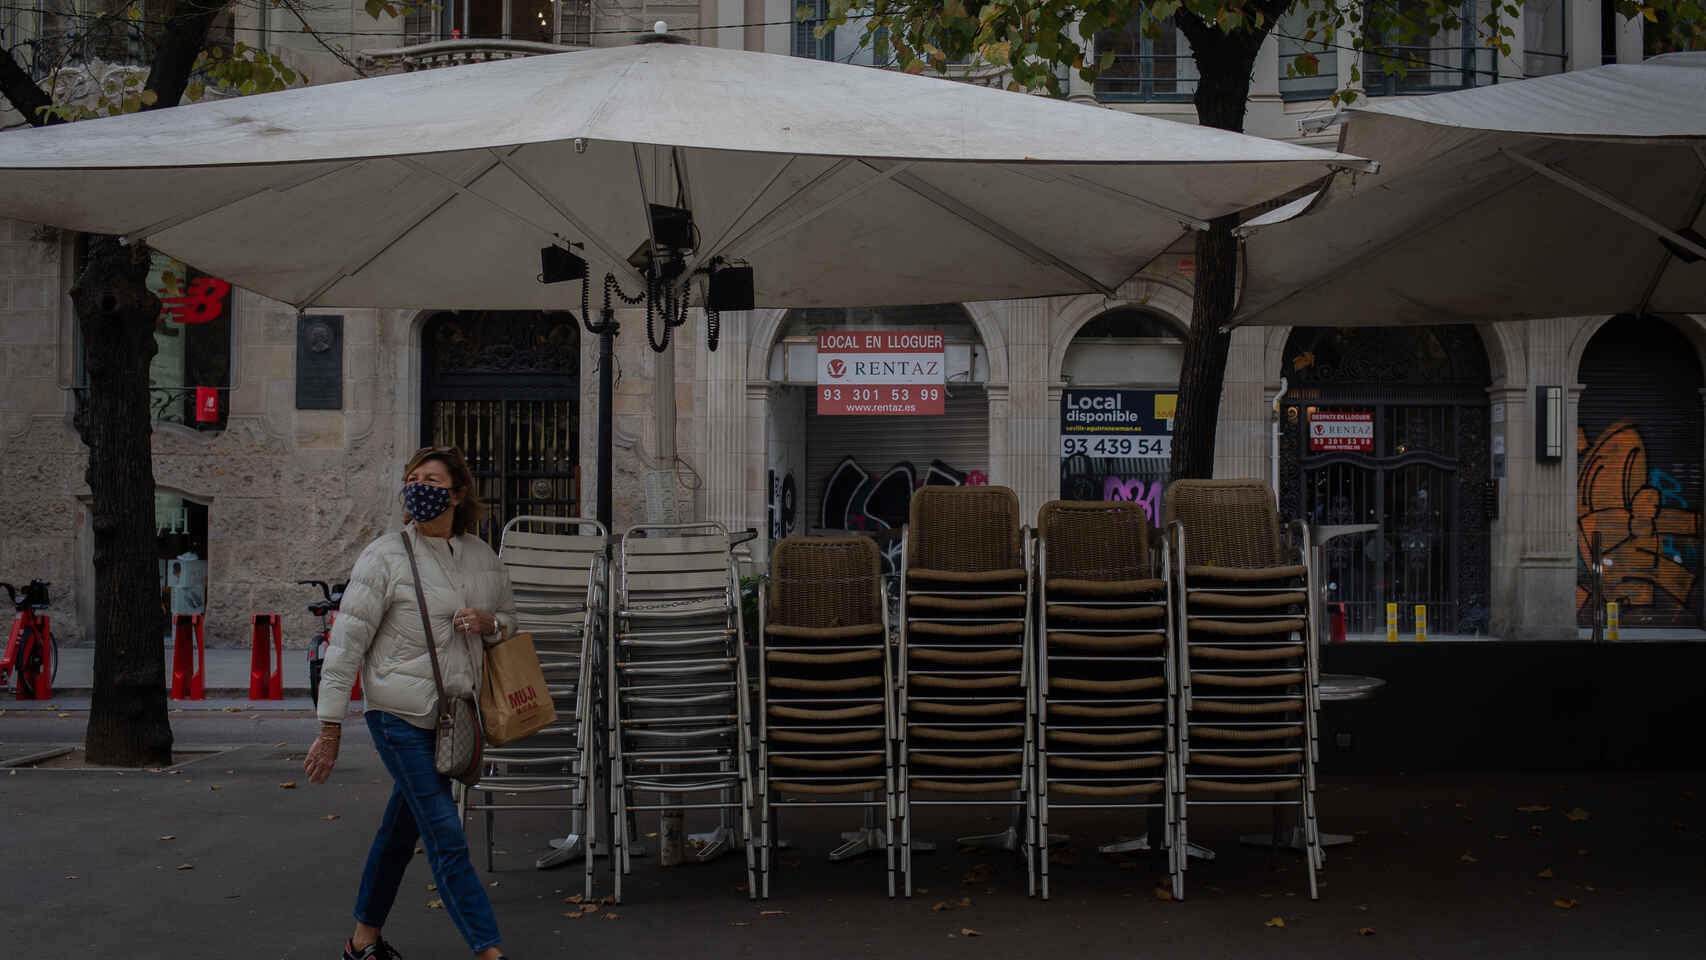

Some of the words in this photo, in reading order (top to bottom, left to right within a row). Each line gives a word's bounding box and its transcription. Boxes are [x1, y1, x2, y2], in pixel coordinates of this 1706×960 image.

[821, 335, 859, 349] LOCAL
[866, 335, 881, 349] EN
[888, 335, 942, 349] LLOGUER
[855, 361, 939, 376] RENTAZ
[823, 389, 841, 401] 93
[852, 389, 879, 401] 301
[891, 389, 910, 401] 53
[920, 389, 939, 401] 99
[1067, 393, 1122, 409] Local
[846, 404, 916, 413] www.rentaz.es
[1066, 410, 1138, 423] disponible
[1329, 425, 1370, 434] RENTAZ
[1064, 438, 1088, 454] 93
[1094, 438, 1132, 454] 439
[1138, 438, 1163, 455] 54
[508, 687, 536, 710] MUJI
